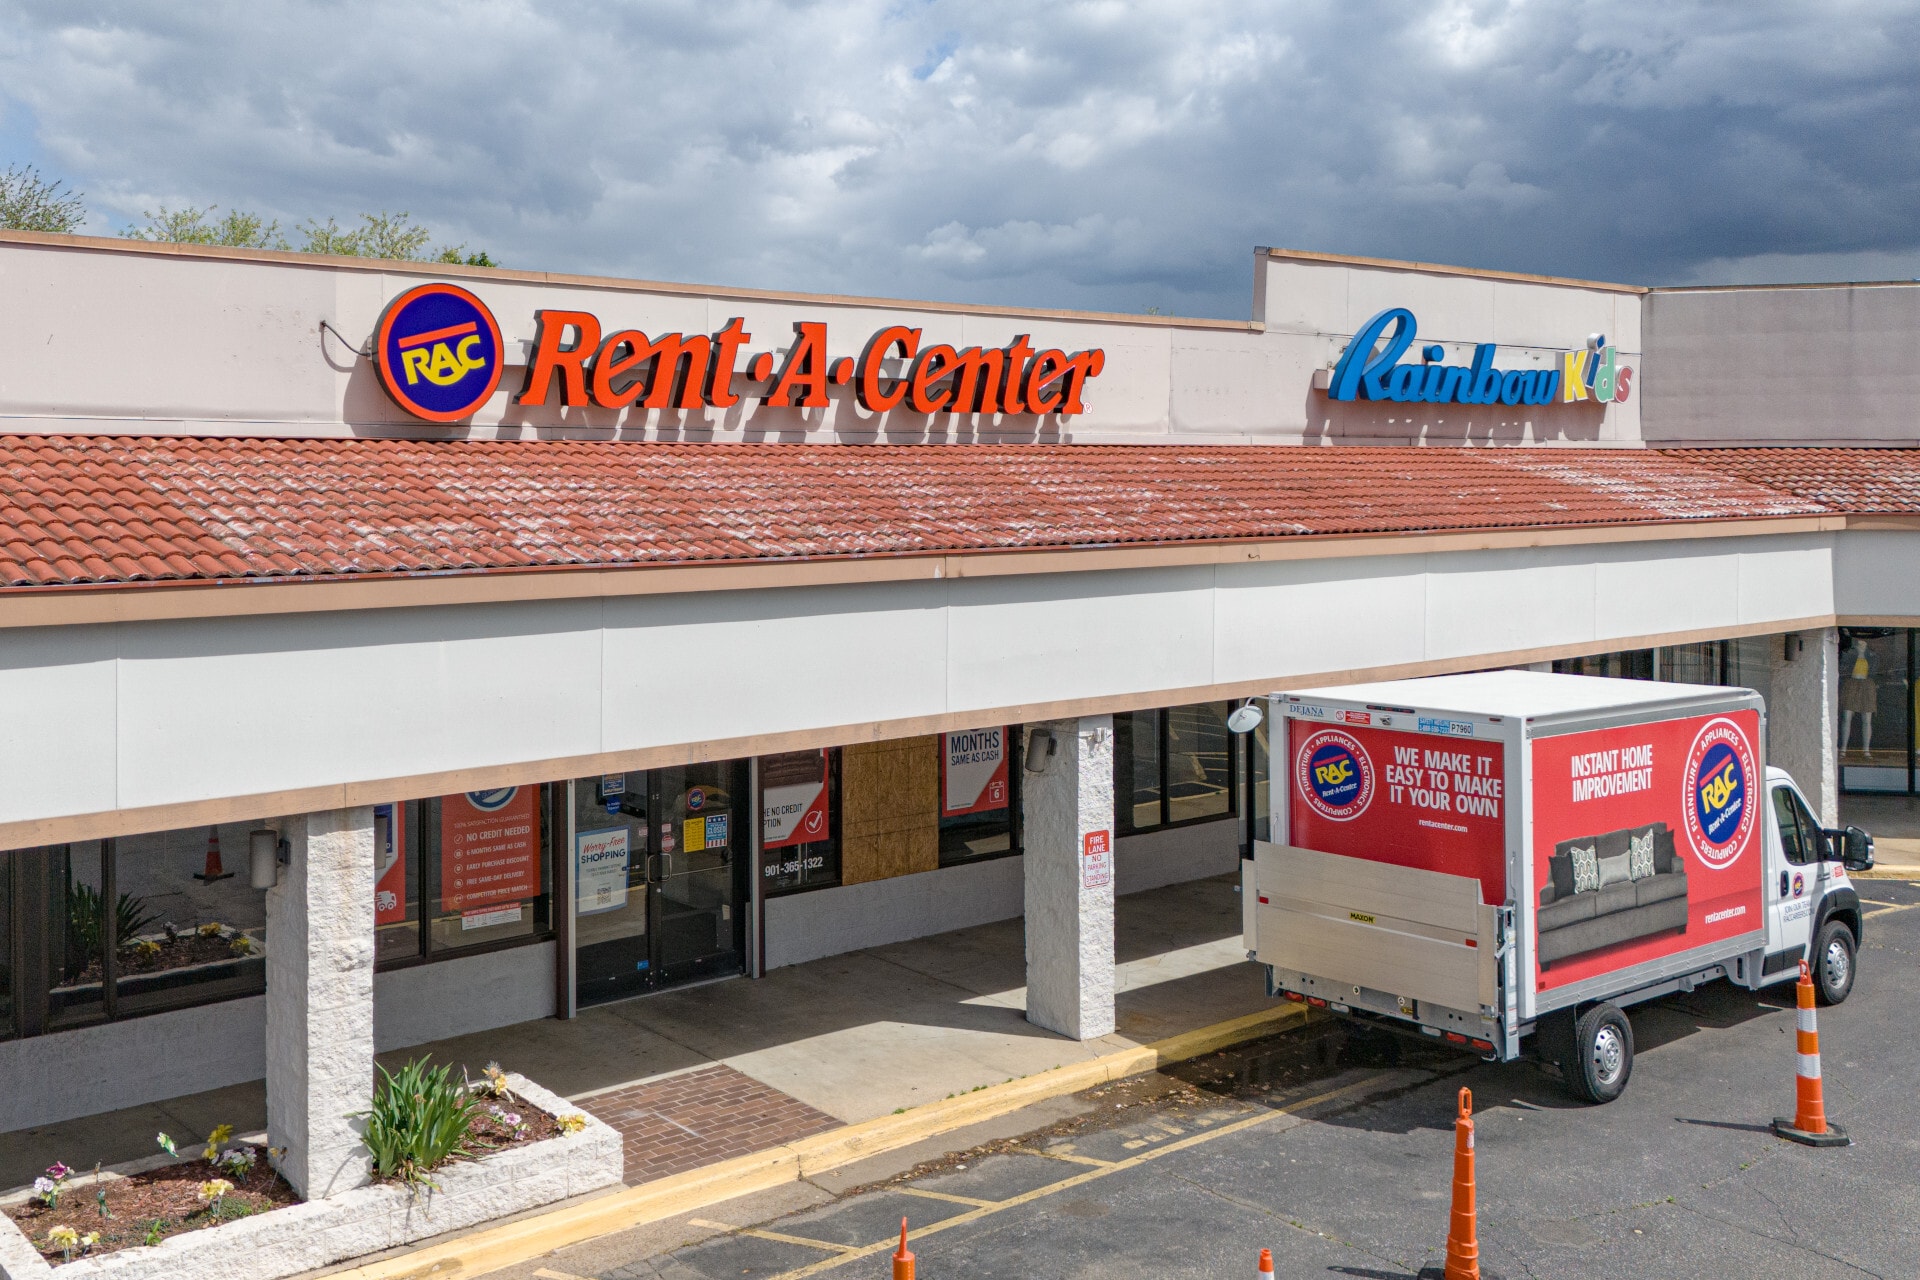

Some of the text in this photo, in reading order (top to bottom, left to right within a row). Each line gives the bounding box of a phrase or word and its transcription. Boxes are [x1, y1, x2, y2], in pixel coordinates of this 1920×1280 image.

[401, 335, 486, 385] RAC
[1328, 307, 1634, 406] Rainbow Kids
[1289, 704, 1324, 716] DEJANA
[951, 731, 1000, 754] MONTHS
[1315, 735, 1356, 751] APPLIANCES
[1700, 727, 1739, 751] APPLIANCES
[951, 750, 1000, 766] SAME AS CASH
[1394, 745, 1493, 776] WE MAKE IT
[1571, 744, 1653, 778] INSTANT HOME
[1301, 748, 1312, 792] FURNITURE
[1315, 759, 1353, 785] RAC
[1357, 755, 1371, 806] ELECTRONICS
[1386, 764, 1502, 798] EASY TO MAKE
[1572, 767, 1653, 803] IMPROVEMENT
[1701, 762, 1738, 814] RAC
[994, 788, 1000, 799] 6
[1390, 784, 1498, 818] IT YOUR OWN
[1687, 758, 1698, 833] FURNITURE
[1741, 752, 1753, 833] ELECTRONICS
[772, 806, 781, 817] NO
[781, 803, 803, 815] CREDIT
[1313, 797, 1353, 816] COMPUTERS
[467, 817, 499, 827] SATISFACTION
[499, 813, 530, 823] GUARANTEED
[763, 817, 782, 828] PTION
[1418, 819, 1468, 833] rentacenter.com
[466, 825, 531, 842] NO CREDIT NEEDED
[1089, 835, 1104, 845] FIRE
[492, 844, 507, 852] SAME
[513, 841, 527, 849] CASH
[583, 836, 626, 854] Worry-Free
[1088, 844, 1106, 854] LANE
[1700, 840, 1738, 860] COMPUTERS
[466, 855, 530, 871] EARLY PURCHASE DISCOUNT
[581, 848, 626, 864] SHOPPING
[1091, 854, 1102, 862] NO
[764, 856, 824, 877] 901-365-1322
[1087, 861, 1107, 871] PARKING
[466, 878, 478, 886] FREE
[503, 870, 525, 880] DELIVERY
[1086, 873, 1109, 883] STANDING
[466, 884, 528, 900] COMPETITOR PRICE MATCH
[1350, 912, 1374, 924] MAXON
[1705, 905, 1746, 924] rentacenter.com
